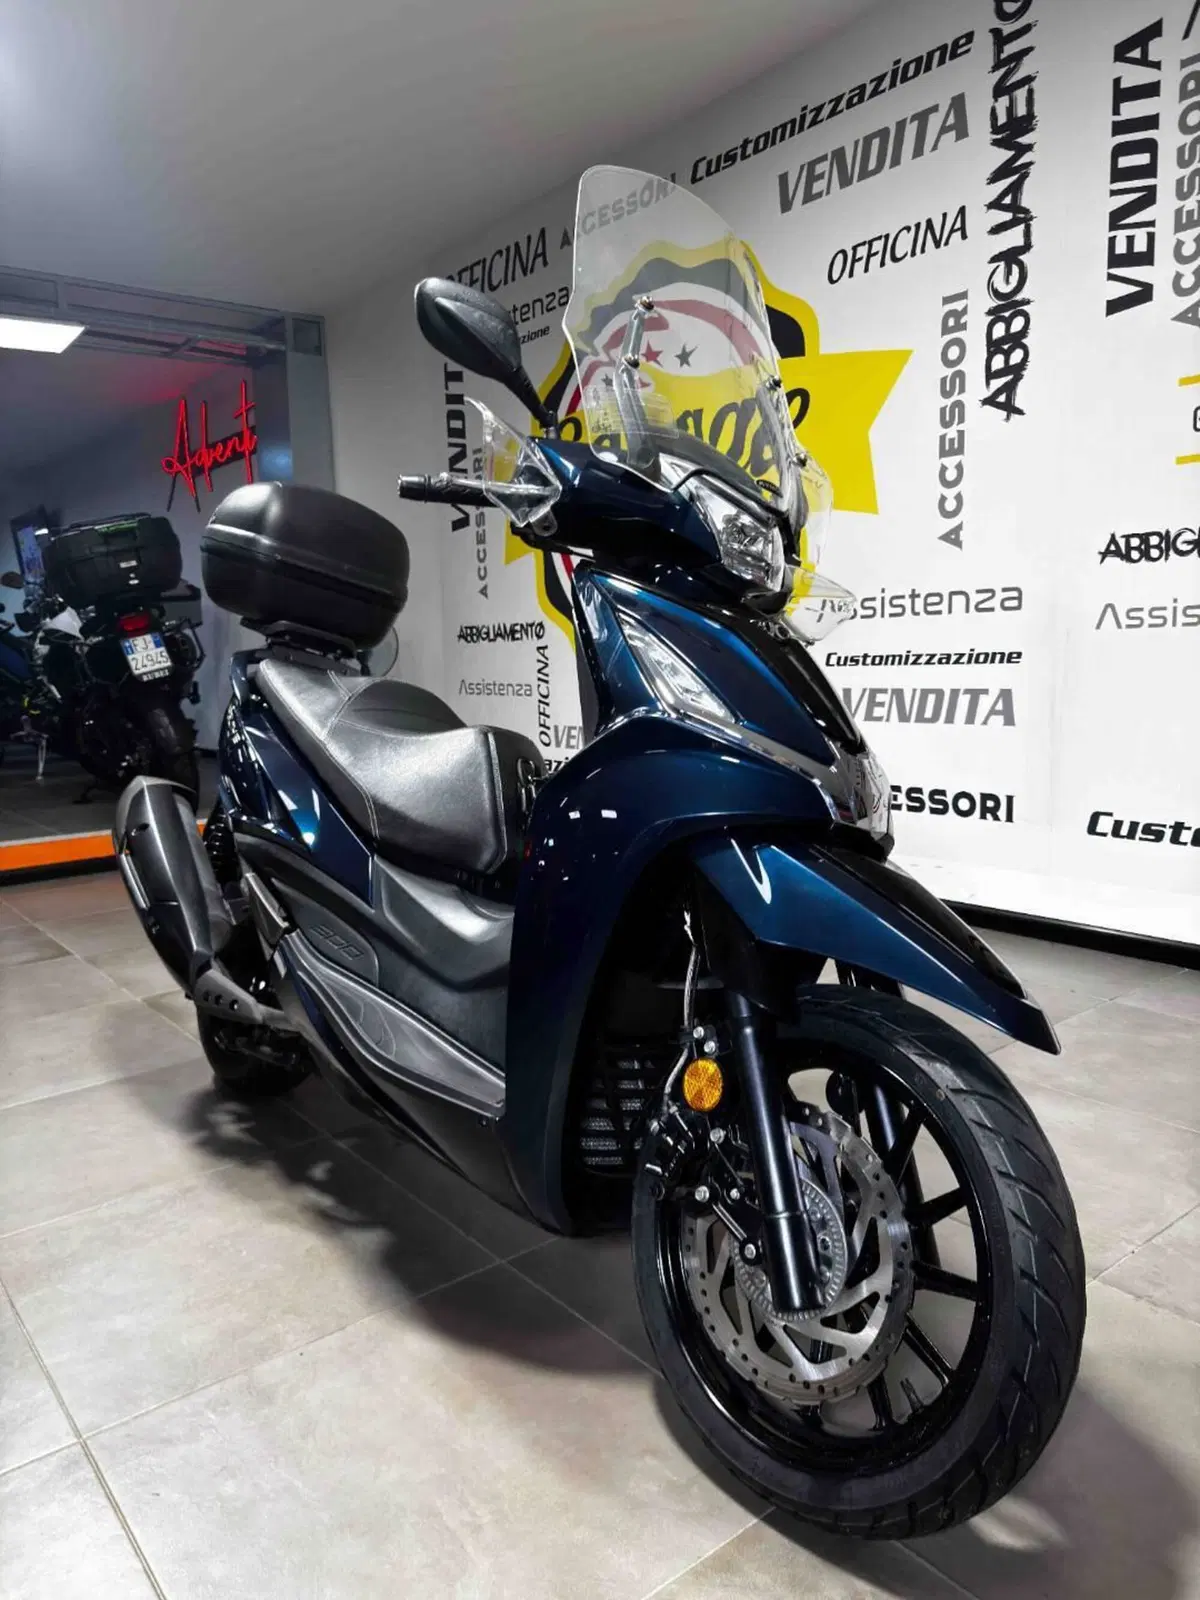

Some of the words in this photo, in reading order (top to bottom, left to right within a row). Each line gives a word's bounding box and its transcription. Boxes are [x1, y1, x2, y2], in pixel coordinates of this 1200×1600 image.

[690, 30, 975, 185] Customizzazione
[778, 92, 969, 215] VENDITA
[1105, 17, 1163, 318] VENDITA
[827, 205, 968, 284] OFFICINA
[508, 286, 569, 325] tenza
[937, 289, 968, 550] ACCESSORI
[1097, 526, 1200, 565] ABBIG
[458, 678, 533, 696] Assistenza
[536, 645, 552, 747] OFFICINA
[825, 648, 1023, 667] Customizzazione
[842, 687, 1016, 727] VENDITA
